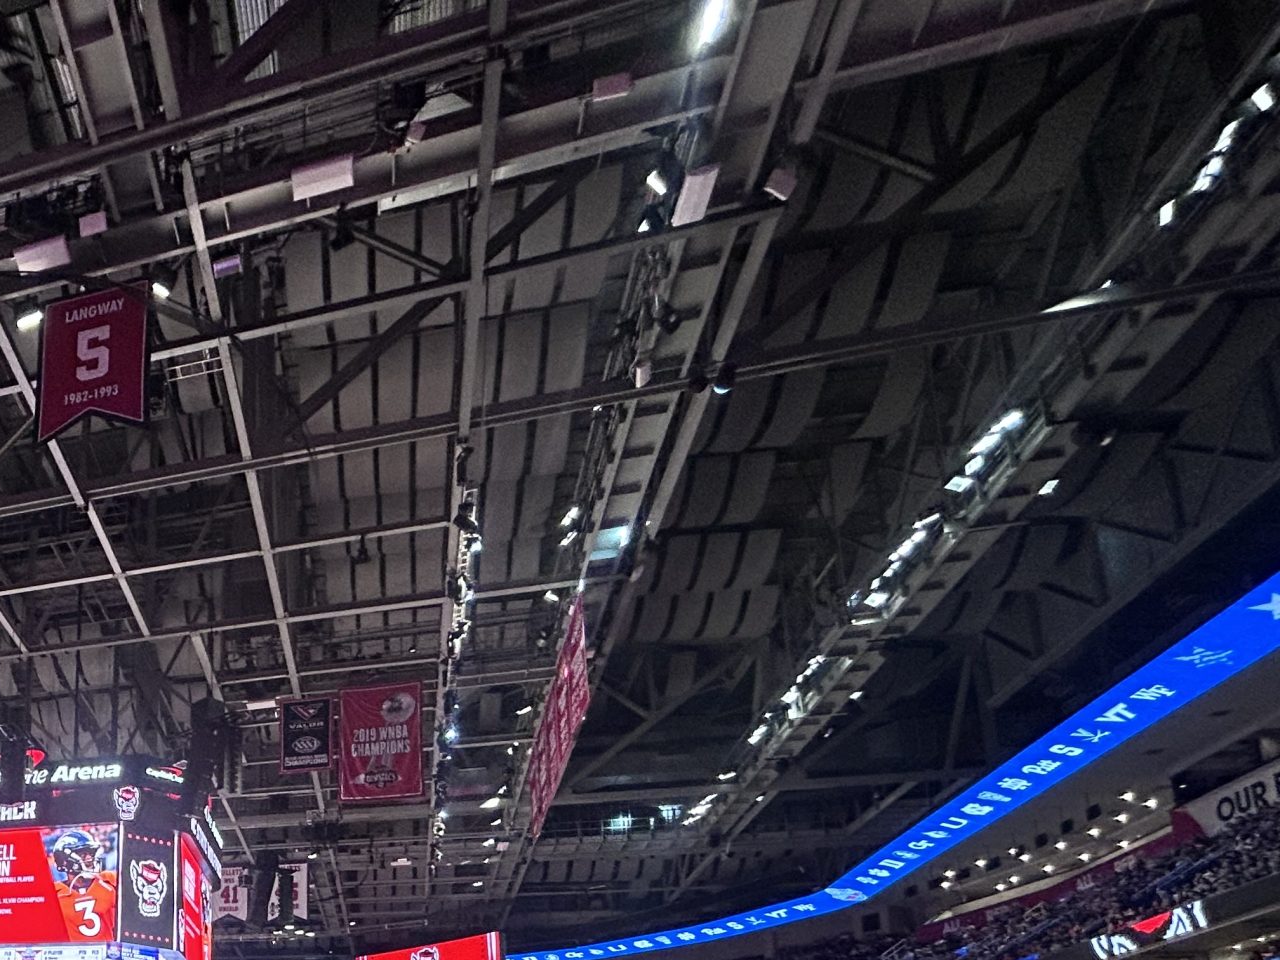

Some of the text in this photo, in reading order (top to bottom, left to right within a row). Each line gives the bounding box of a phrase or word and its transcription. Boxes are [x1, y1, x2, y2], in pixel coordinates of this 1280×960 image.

[65, 298, 124, 323] LANGWAY
[76, 325, 110, 381] 5
[64, 384, 119, 405] 1982-1993
[353, 724, 409, 743] 2019 WNBA
[351, 739, 411, 757] CHAMPIONS
[51, 764, 121, 783] Arena
[1216, 783, 1267, 822] OUR
[221, 886, 238, 904] 41
[74, 899, 101, 937] 3
